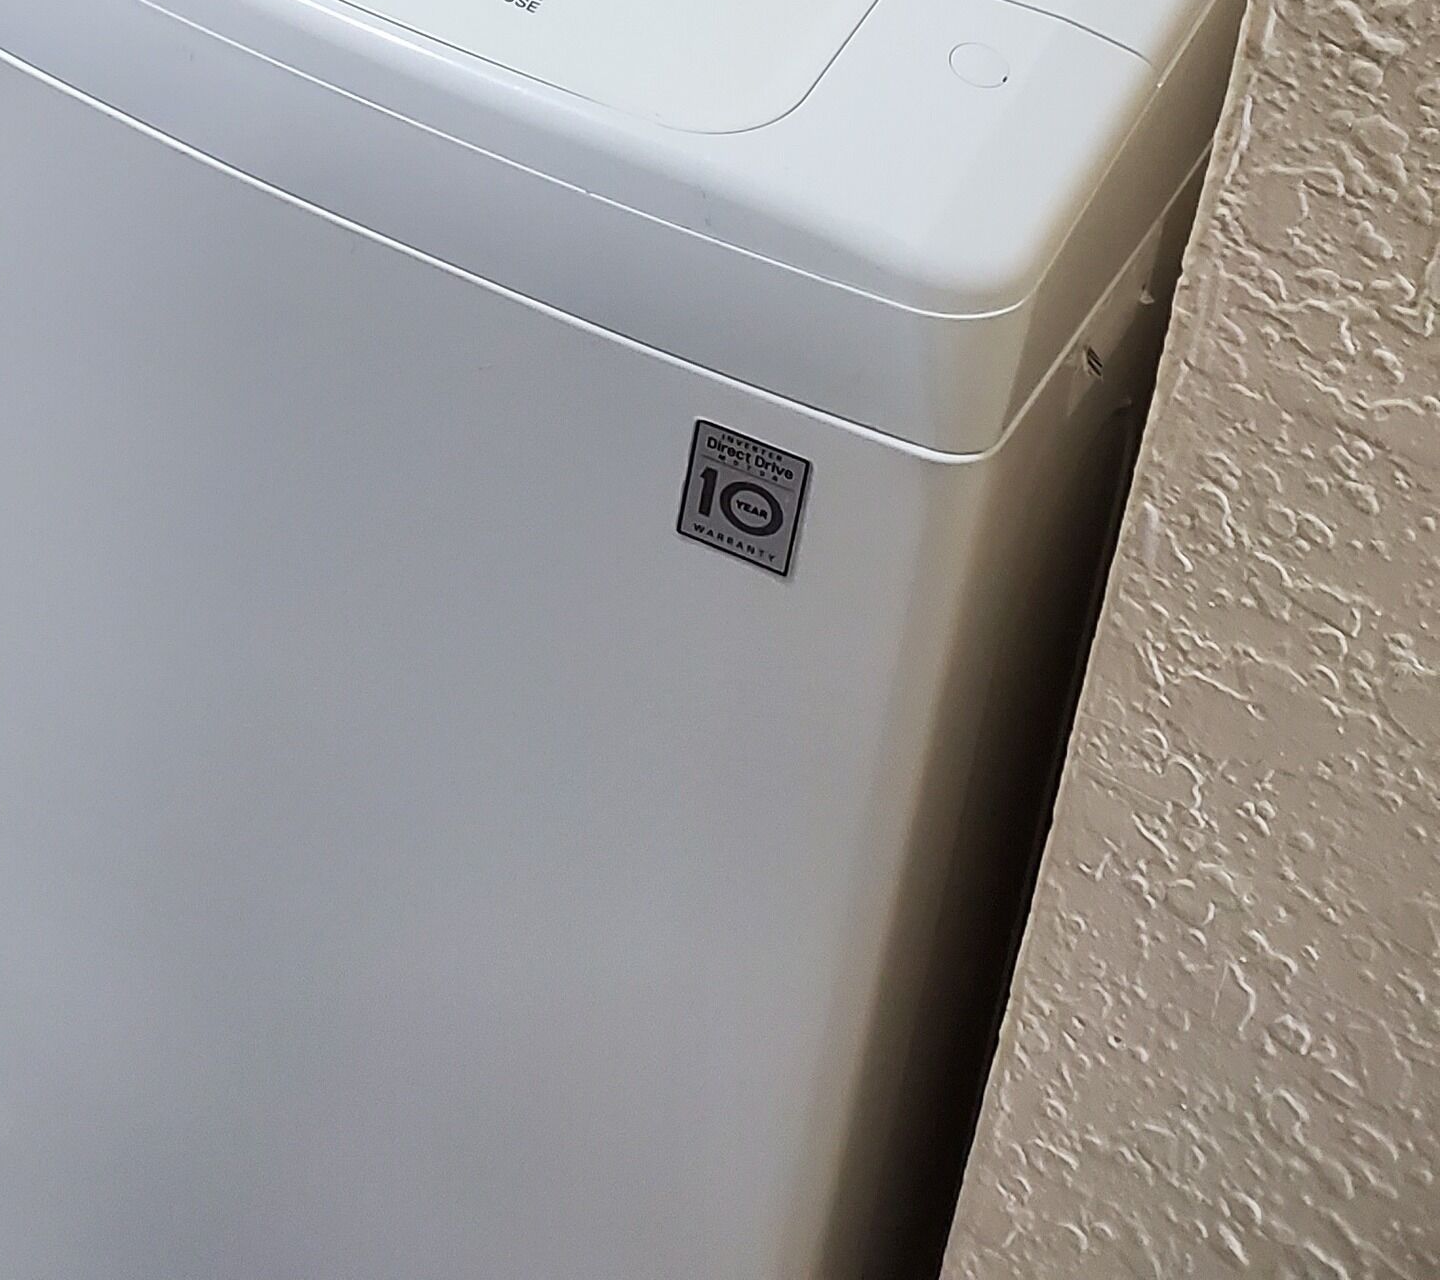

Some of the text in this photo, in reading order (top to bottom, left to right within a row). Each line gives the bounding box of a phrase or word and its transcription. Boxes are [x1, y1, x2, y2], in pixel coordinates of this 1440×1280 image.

[706, 436, 794, 480] Direct Drive
[721, 433, 783, 462] INVERTER
[699, 466, 784, 536] 10
[736, 500, 768, 520] YEAR
[693, 523, 776, 562] WARRANTY
